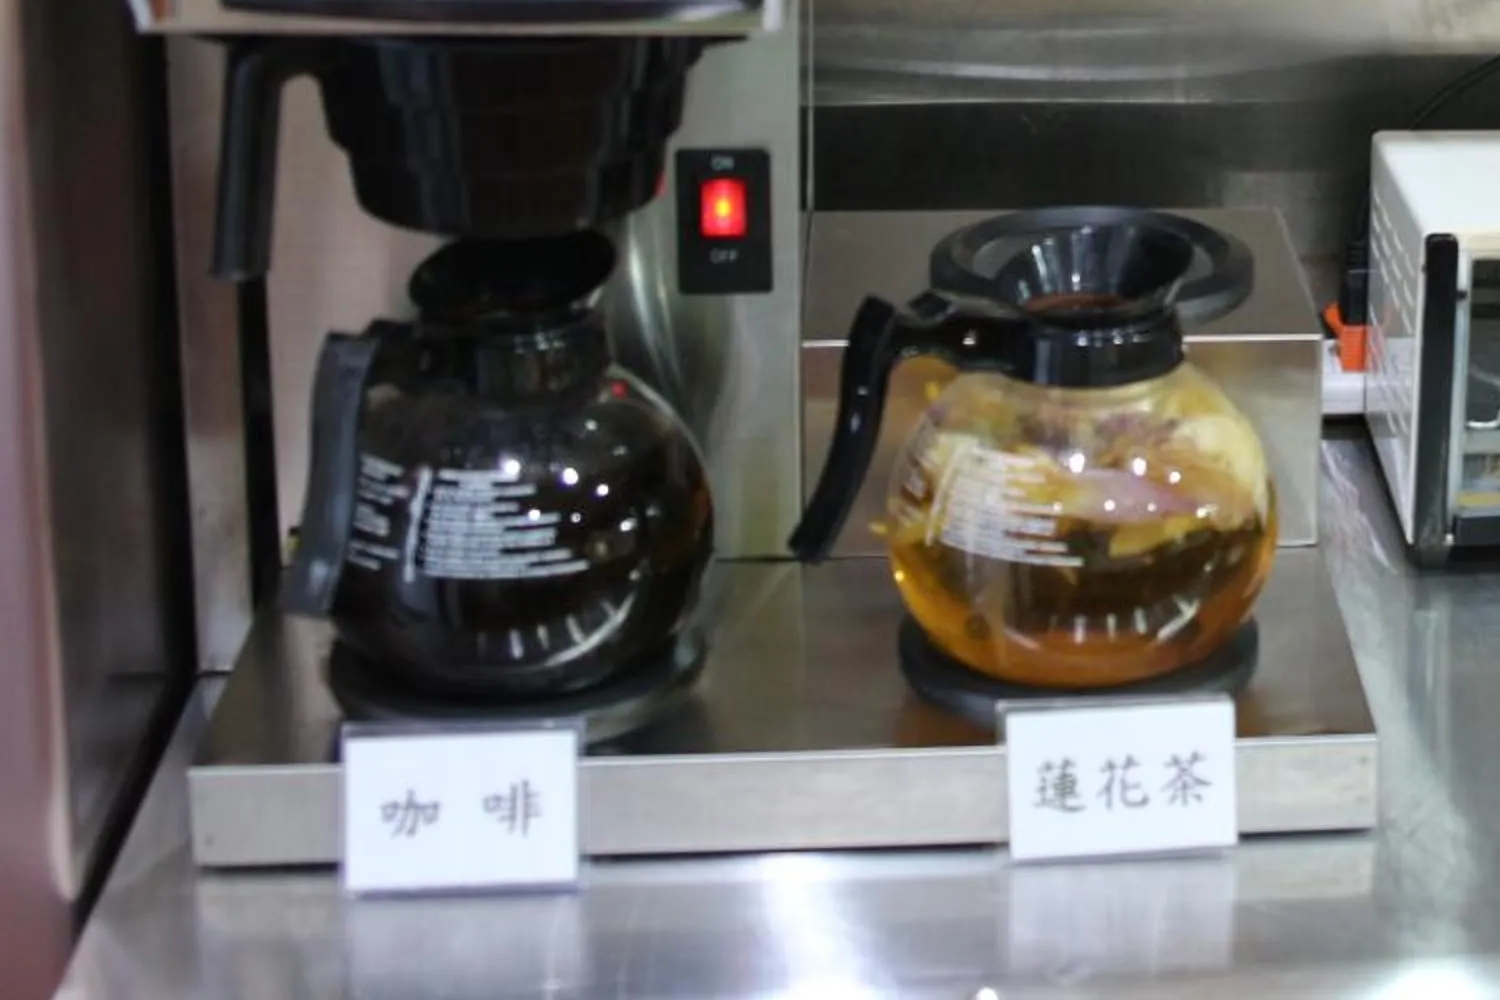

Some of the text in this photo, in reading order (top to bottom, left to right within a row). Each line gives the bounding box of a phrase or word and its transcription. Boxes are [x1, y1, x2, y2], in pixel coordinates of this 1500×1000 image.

[379, 779, 543, 838] 咖啡
[1033, 751, 1213, 813] 蓮花茶
